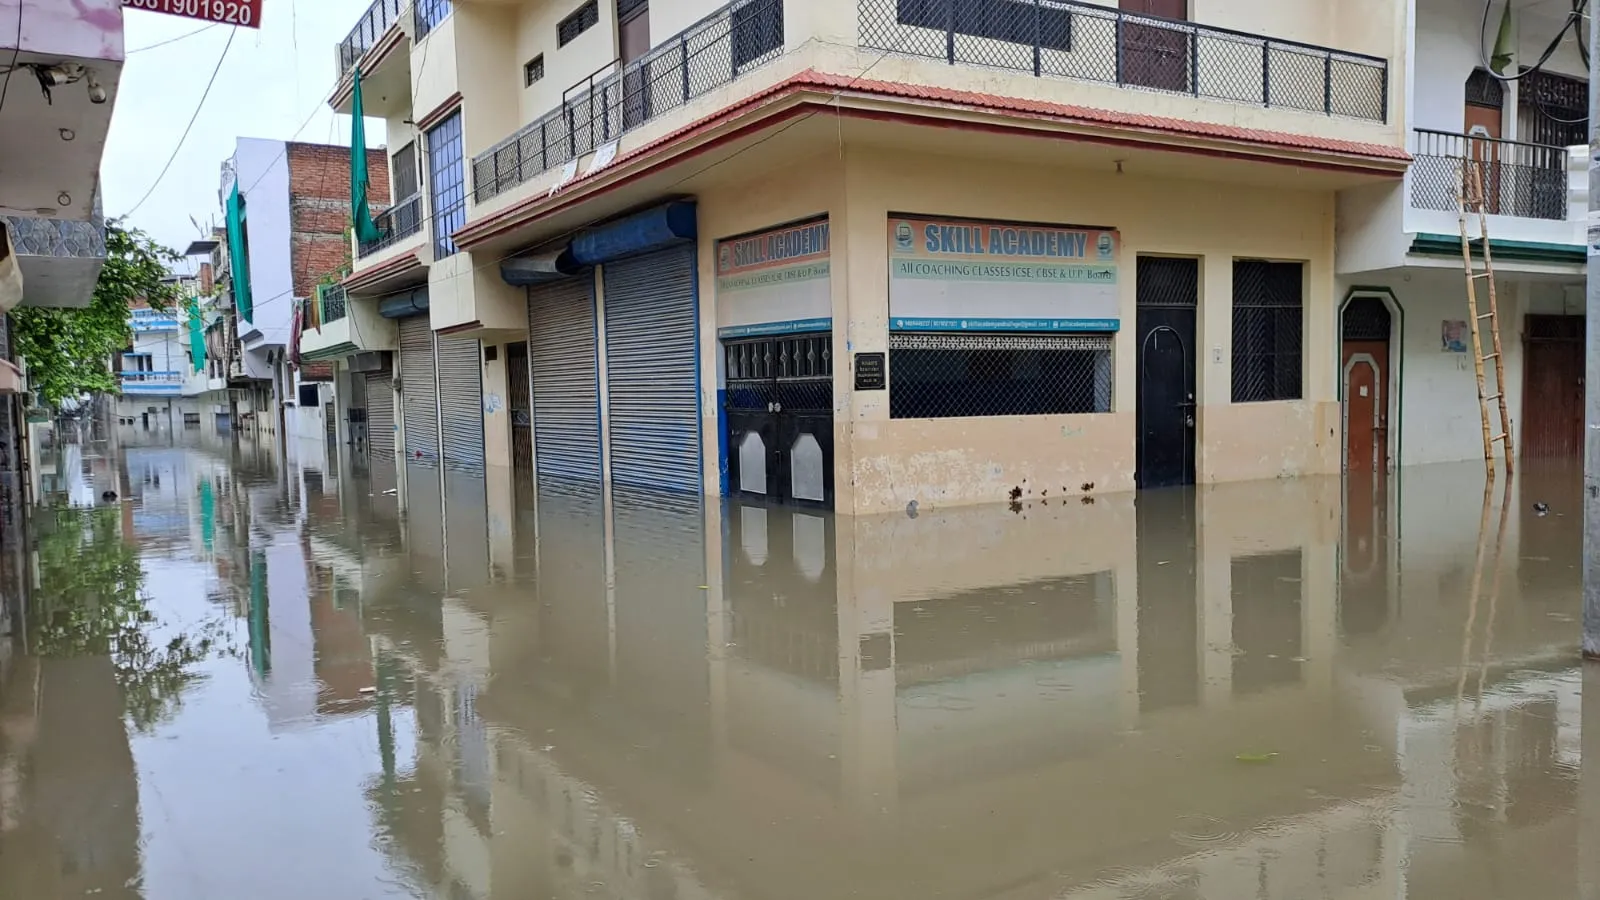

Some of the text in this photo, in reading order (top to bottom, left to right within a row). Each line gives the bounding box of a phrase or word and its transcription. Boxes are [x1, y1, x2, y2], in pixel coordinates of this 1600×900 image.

[121, 0, 251, 24] 1901920
[734, 224, 830, 268] SKILL ACADEMY
[924, 223, 1087, 258] SKILL ACADEMY
[915, 263, 970, 276] COACHING
[972, 265, 1010, 278] CLASSES
[1059, 269, 1066, 279] &
